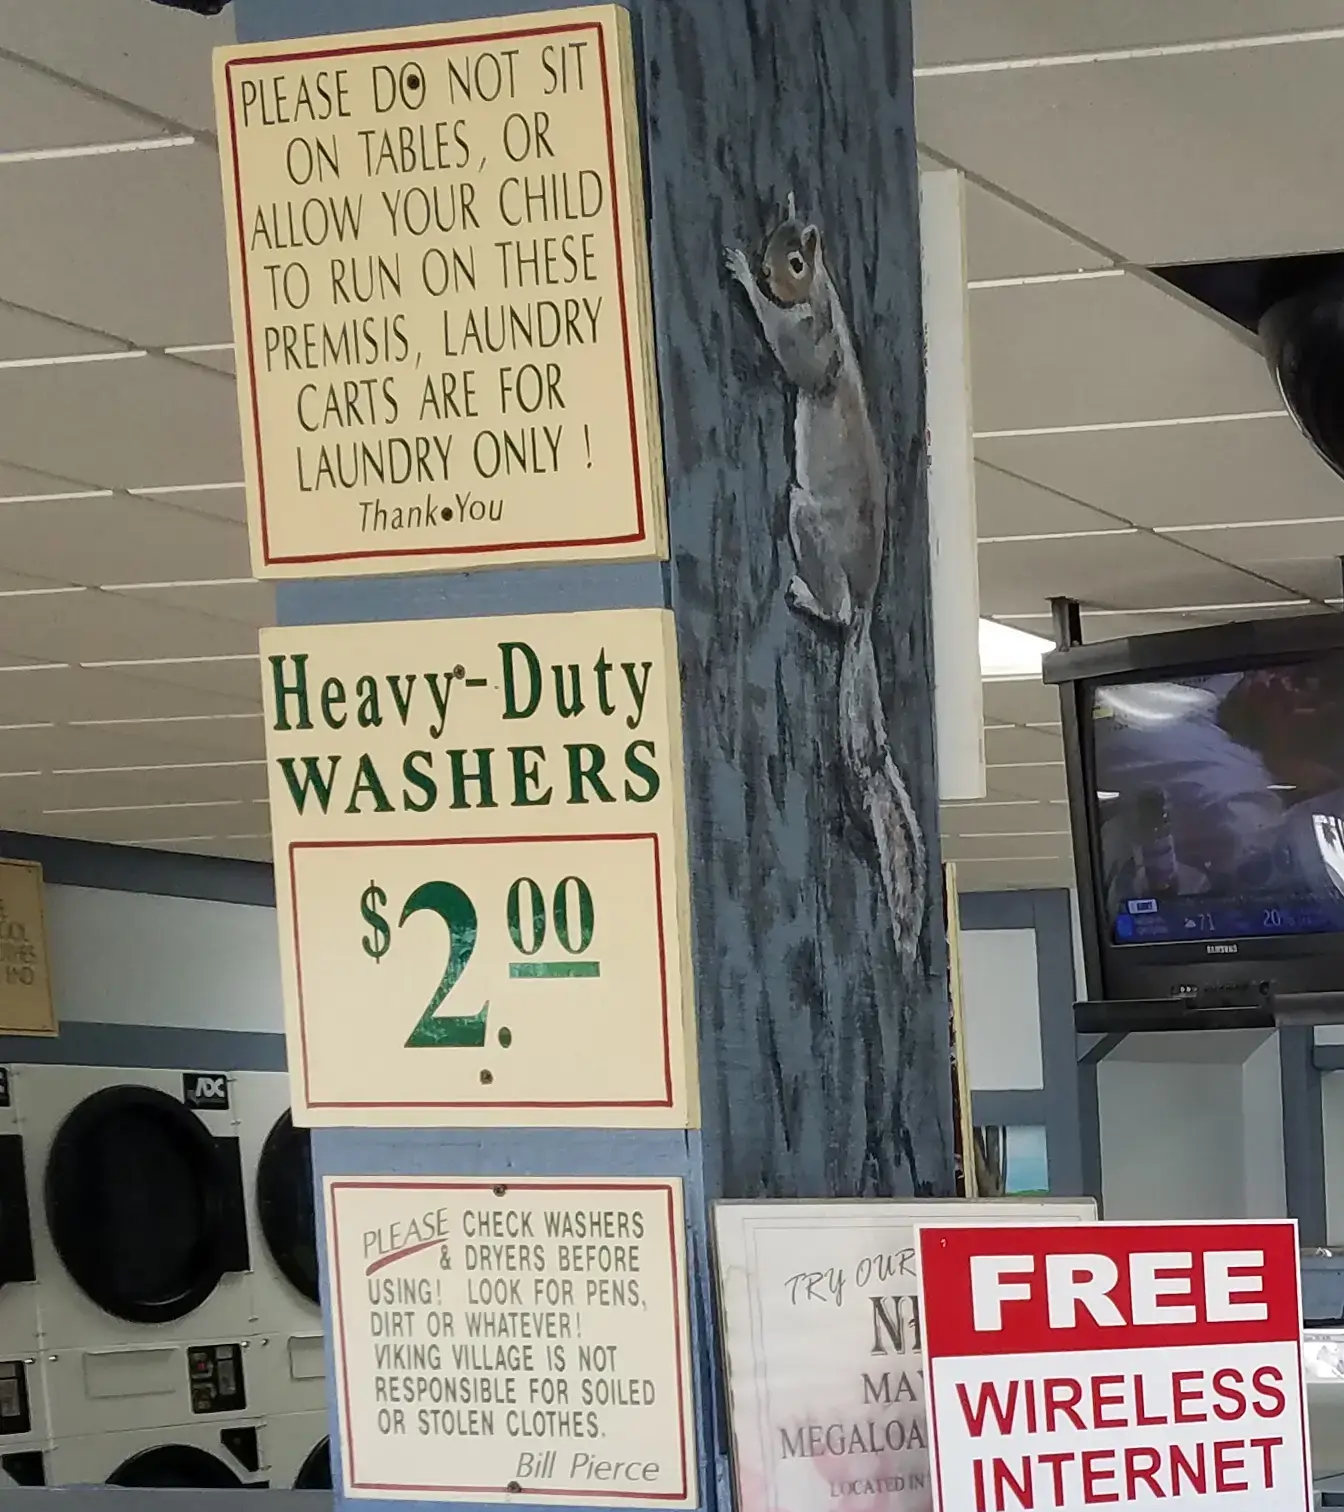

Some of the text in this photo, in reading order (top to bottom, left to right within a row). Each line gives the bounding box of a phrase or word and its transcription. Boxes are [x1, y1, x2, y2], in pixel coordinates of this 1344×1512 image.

[241, 43, 589, 126] PLEASE DO NOT SIT
[286, 112, 554, 186] ON TABLES, OR
[250, 169, 604, 251] ALLOW YOUR CHILD
[264, 234, 598, 311] TO RUN ON THESE
[265, 297, 603, 372] PREMISIS, LAUNDRY
[296, 363, 566, 432] CARTS ARE FOR
[296, 435, 454, 493] LAUNDRY
[473, 425, 565, 479] ONLY
[358, 491, 503, 534] Thank You
[268, 641, 653, 738] Heavy-Duty
[276, 739, 660, 816] WASHERS
[363, 1208, 644, 1258] PLEASE CHECK WASHERS
[465, 1245, 545, 1271] DRYERS
[559, 1245, 639, 1271] BEFORE
[368, 1278, 647, 1311] USING! LOOK FOR PENS,
[785, 1249, 916, 1305] TRY OUR
[970, 1250, 1268, 1332] FREE
[371, 1313, 581, 1338] DIRT OR WHATEVER!
[375, 1344, 617, 1371] VIKING VILLAGE IS NOT
[375, 1377, 655, 1406] RESPONSIBLE FOR SOILED
[863, 1372, 922, 1404] MA
[956, 1366, 1286, 1438] WIRELESS
[378, 1409, 605, 1437] OR STOLEN CLOTHES.
[516, 1451, 660, 1481] Bill Pierce
[830, 1475, 924, 1498] LOCATED IN
